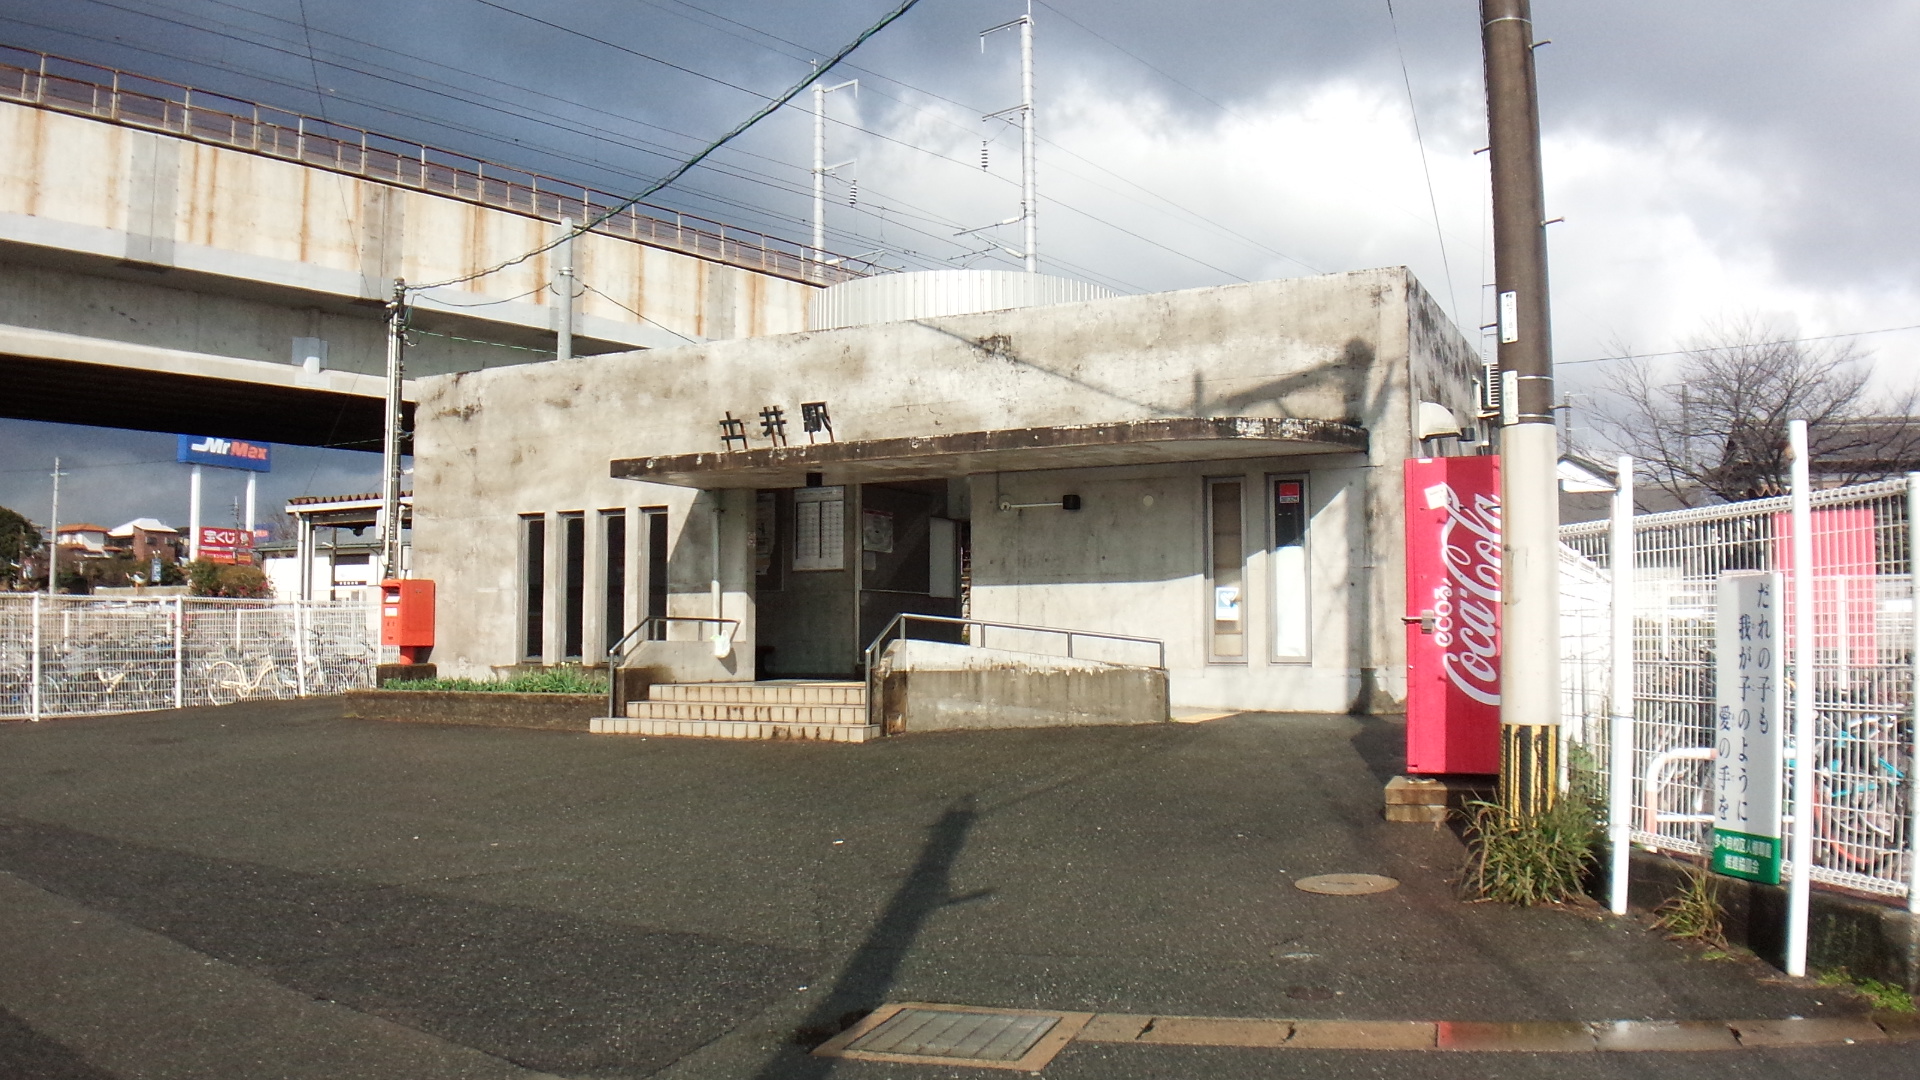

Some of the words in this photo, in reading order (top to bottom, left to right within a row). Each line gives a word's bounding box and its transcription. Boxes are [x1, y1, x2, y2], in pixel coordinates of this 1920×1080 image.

[1441, 481, 1502, 706] Coca-Cola
[1757, 582, 1771, 735] だれの子も
[1718, 705, 1731, 821] 愛の手を
[1738, 613, 1751, 821] 我が子のように
